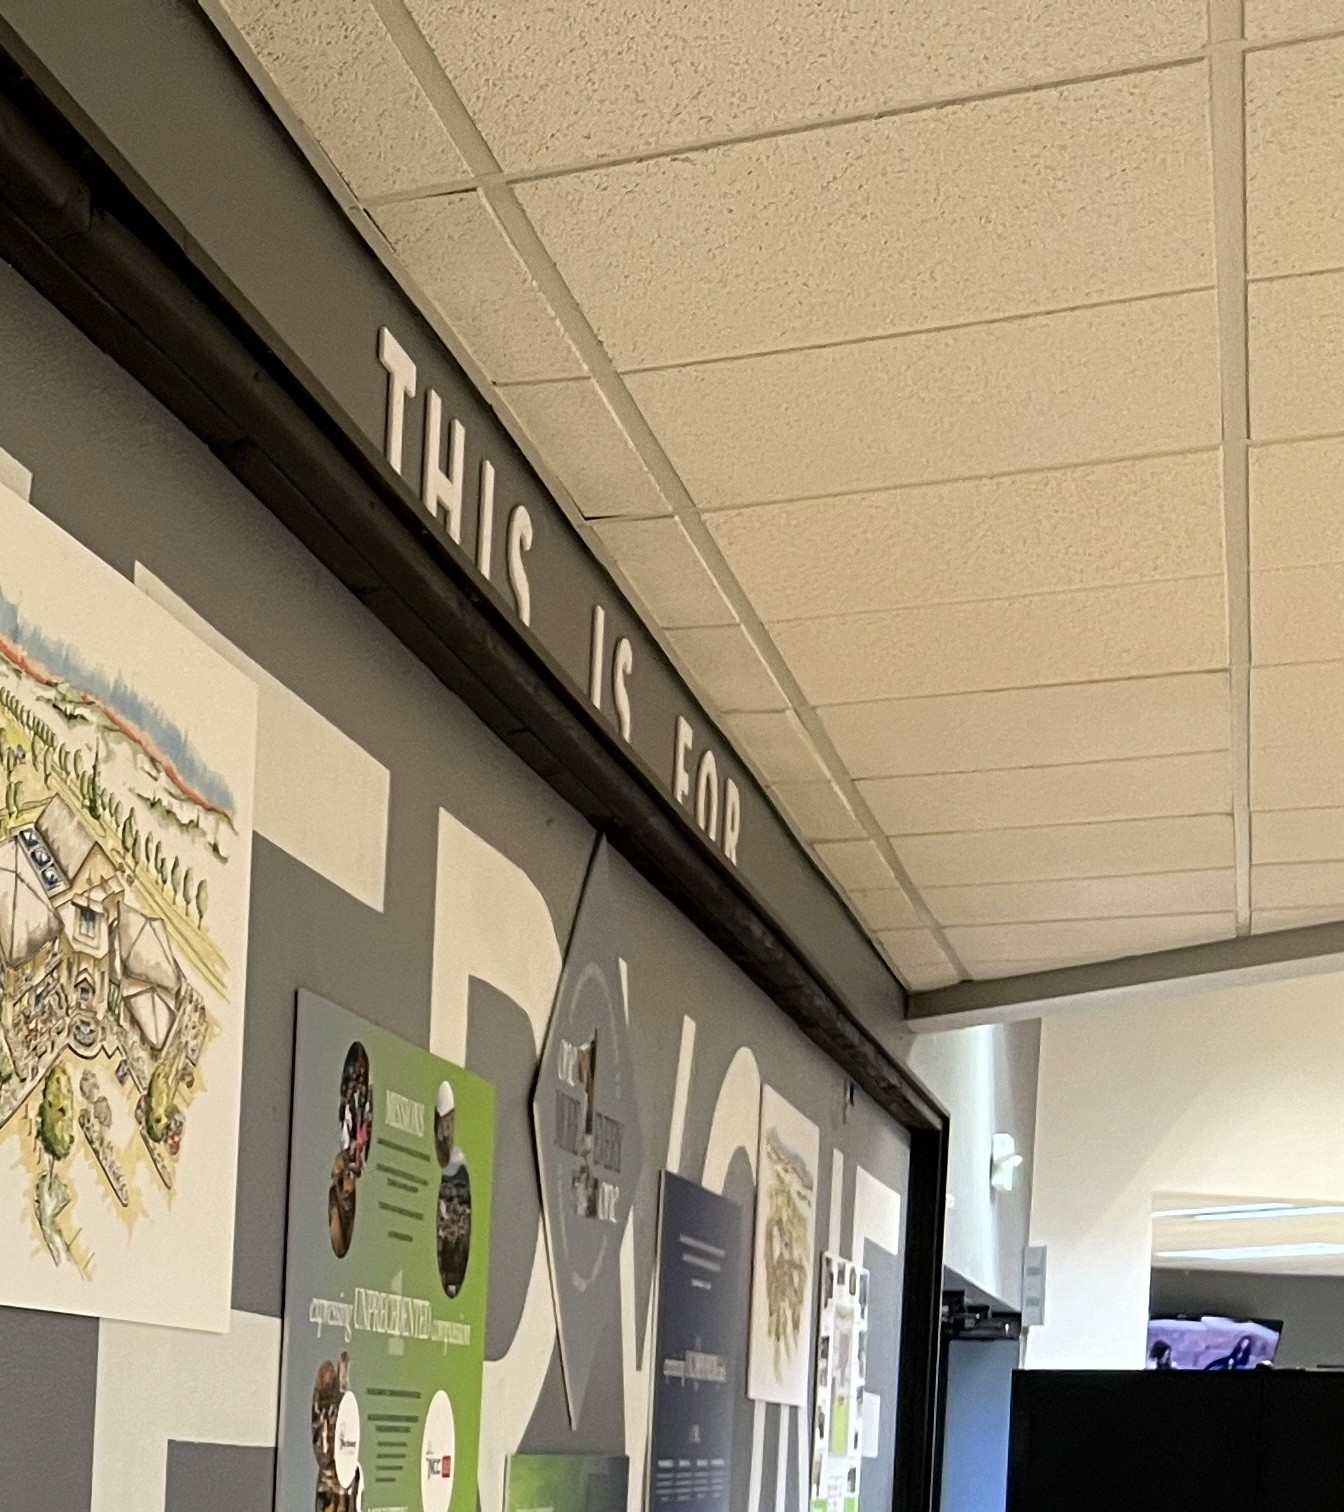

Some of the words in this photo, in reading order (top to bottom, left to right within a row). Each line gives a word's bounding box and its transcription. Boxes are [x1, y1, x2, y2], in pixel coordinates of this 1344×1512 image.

[378, 326, 533, 627] THIS
[590, 605, 632, 743] IS
[674, 716, 741, 866] FOR
